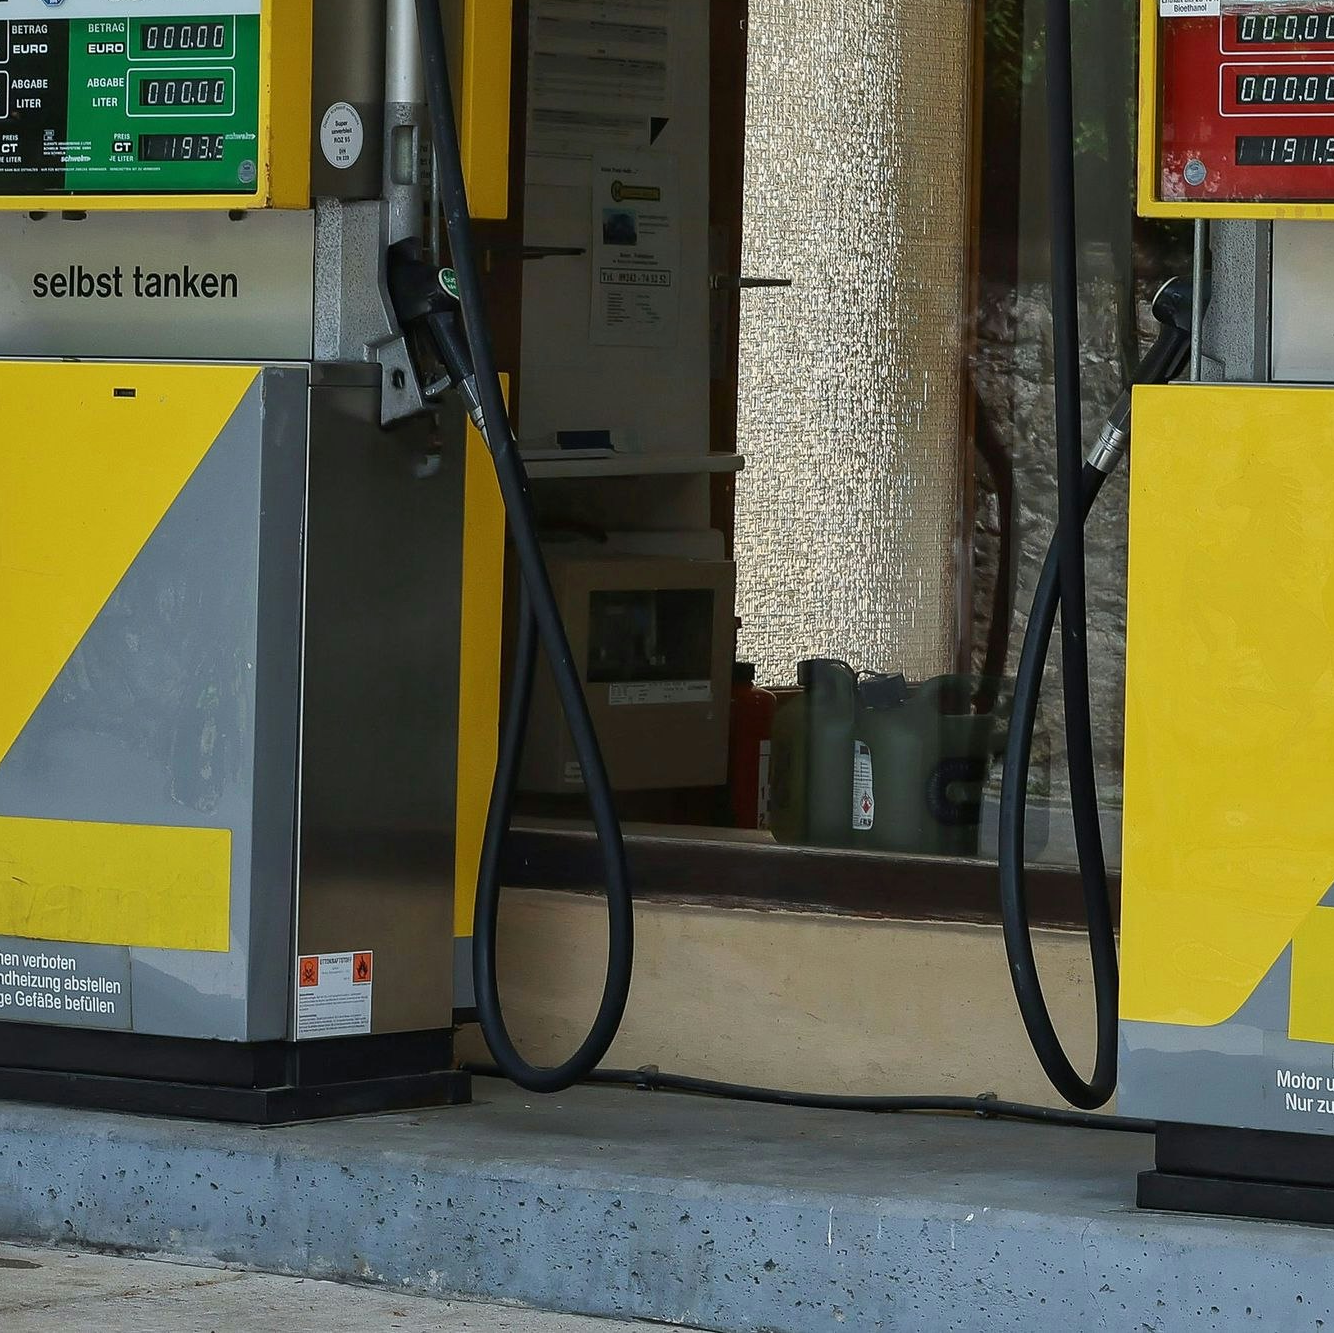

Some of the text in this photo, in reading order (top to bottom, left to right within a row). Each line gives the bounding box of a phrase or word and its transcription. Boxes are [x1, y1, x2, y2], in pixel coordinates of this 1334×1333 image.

[1174, 3, 1207, 13] Bioethanol
[11, 24, 48, 35] BETRAG
[88, 23, 125, 33] BETRAG
[13, 44, 48, 54] EURO
[88, 43, 124, 53] EURO
[11, 79, 48, 89] ABGABE
[87, 78, 125, 88] ABGABE
[16, 99, 42, 108] LITER
[92, 97, 118, 107] LITER
[1, 143, 18, 153] CT
[114, 142, 132, 152] CT
[33, 265, 238, 298] selbst tanken
[22, 953, 76, 971] verboten
[64, 975, 121, 994] abstellen
[15, 991, 62, 1009] Gefäße
[65, 996, 115, 1014] befüllen
[1276, 1070, 1322, 1091] Motor
[1285, 1093, 1314, 1113] Nur
